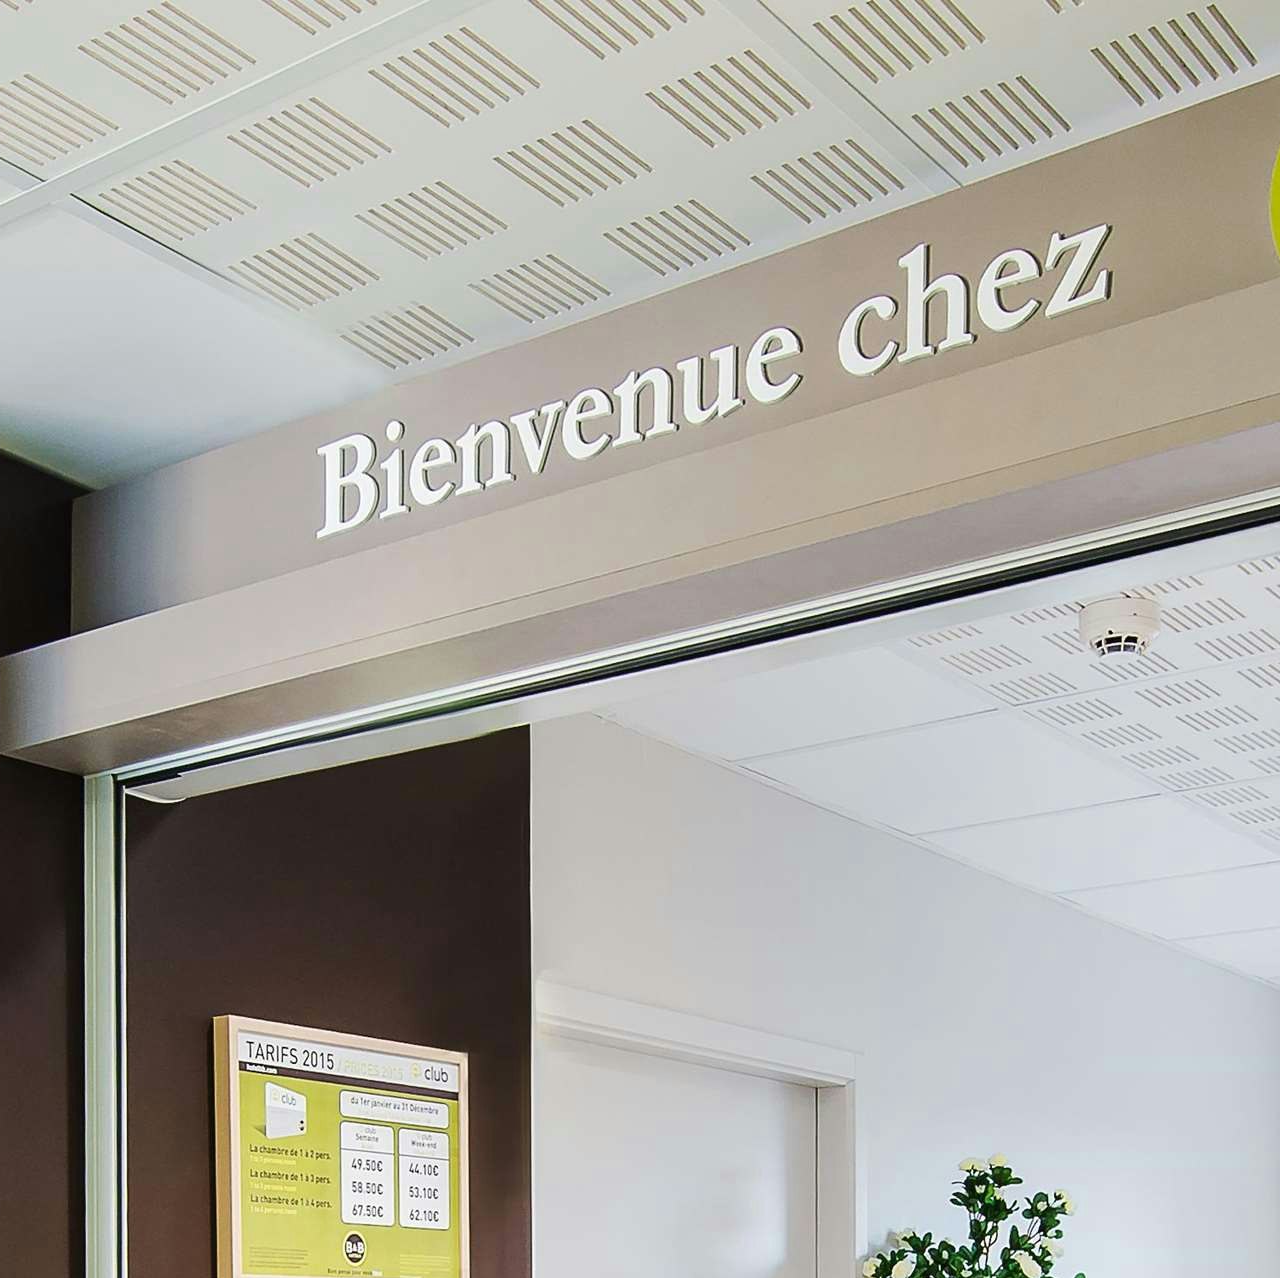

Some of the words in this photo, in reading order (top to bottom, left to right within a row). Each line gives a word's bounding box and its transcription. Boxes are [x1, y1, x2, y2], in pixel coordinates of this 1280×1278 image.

[316, 324, 802, 540] Bienvenue
[838, 222, 1114, 378] chez
[246, 1040, 298, 1065] TARIFS
[302, 1049, 335, 1070] 2015
[424, 1065, 449, 1083] club
[351, 1158, 383, 1172] 49.50€
[409, 1162, 440, 1176] 44.10€
[409, 1186, 440, 1200] 53.10€
[352, 1204, 384, 1218] 67.50€
[409, 1209, 440, 1222] 62.10€
[345, 1240, 365, 1254] B&B
